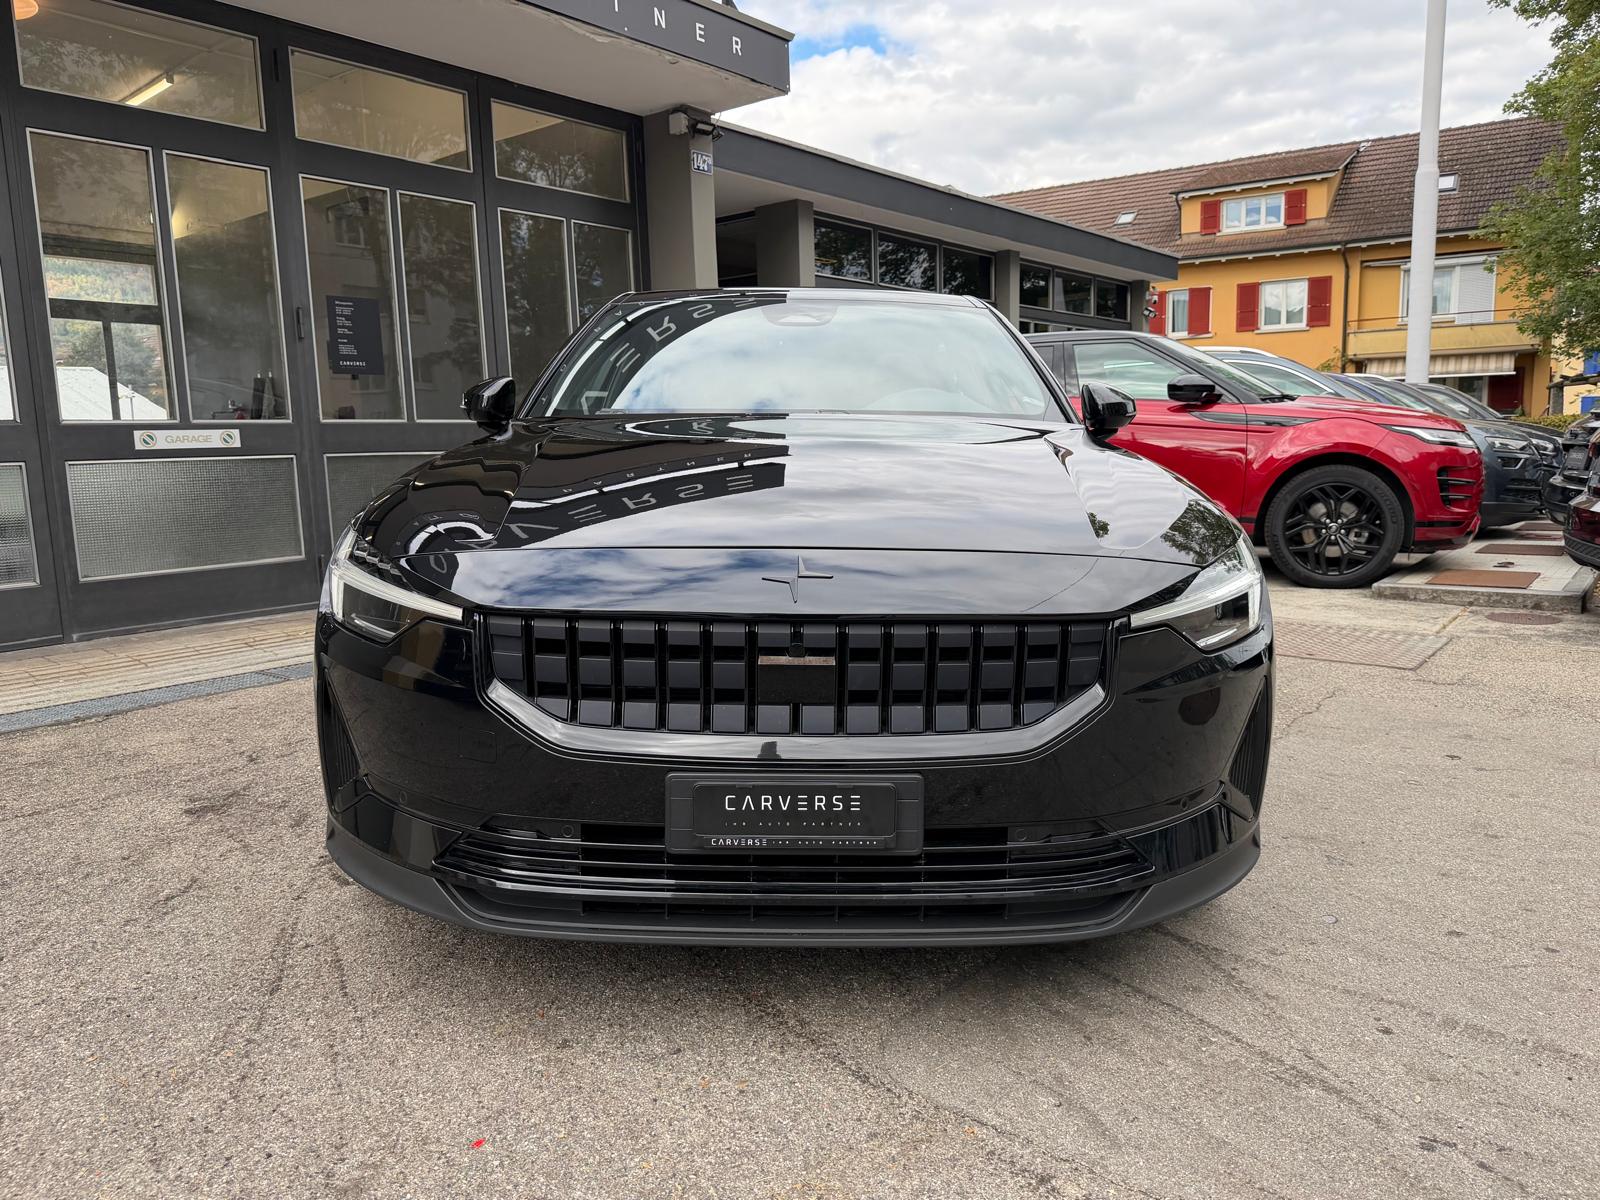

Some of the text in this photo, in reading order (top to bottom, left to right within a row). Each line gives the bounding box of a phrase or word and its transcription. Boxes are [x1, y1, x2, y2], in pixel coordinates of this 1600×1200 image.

[165, 434, 214, 444] GARAGE
[724, 795, 862, 811] CARVERSE
[711, 838, 768, 846] CARVERSE
